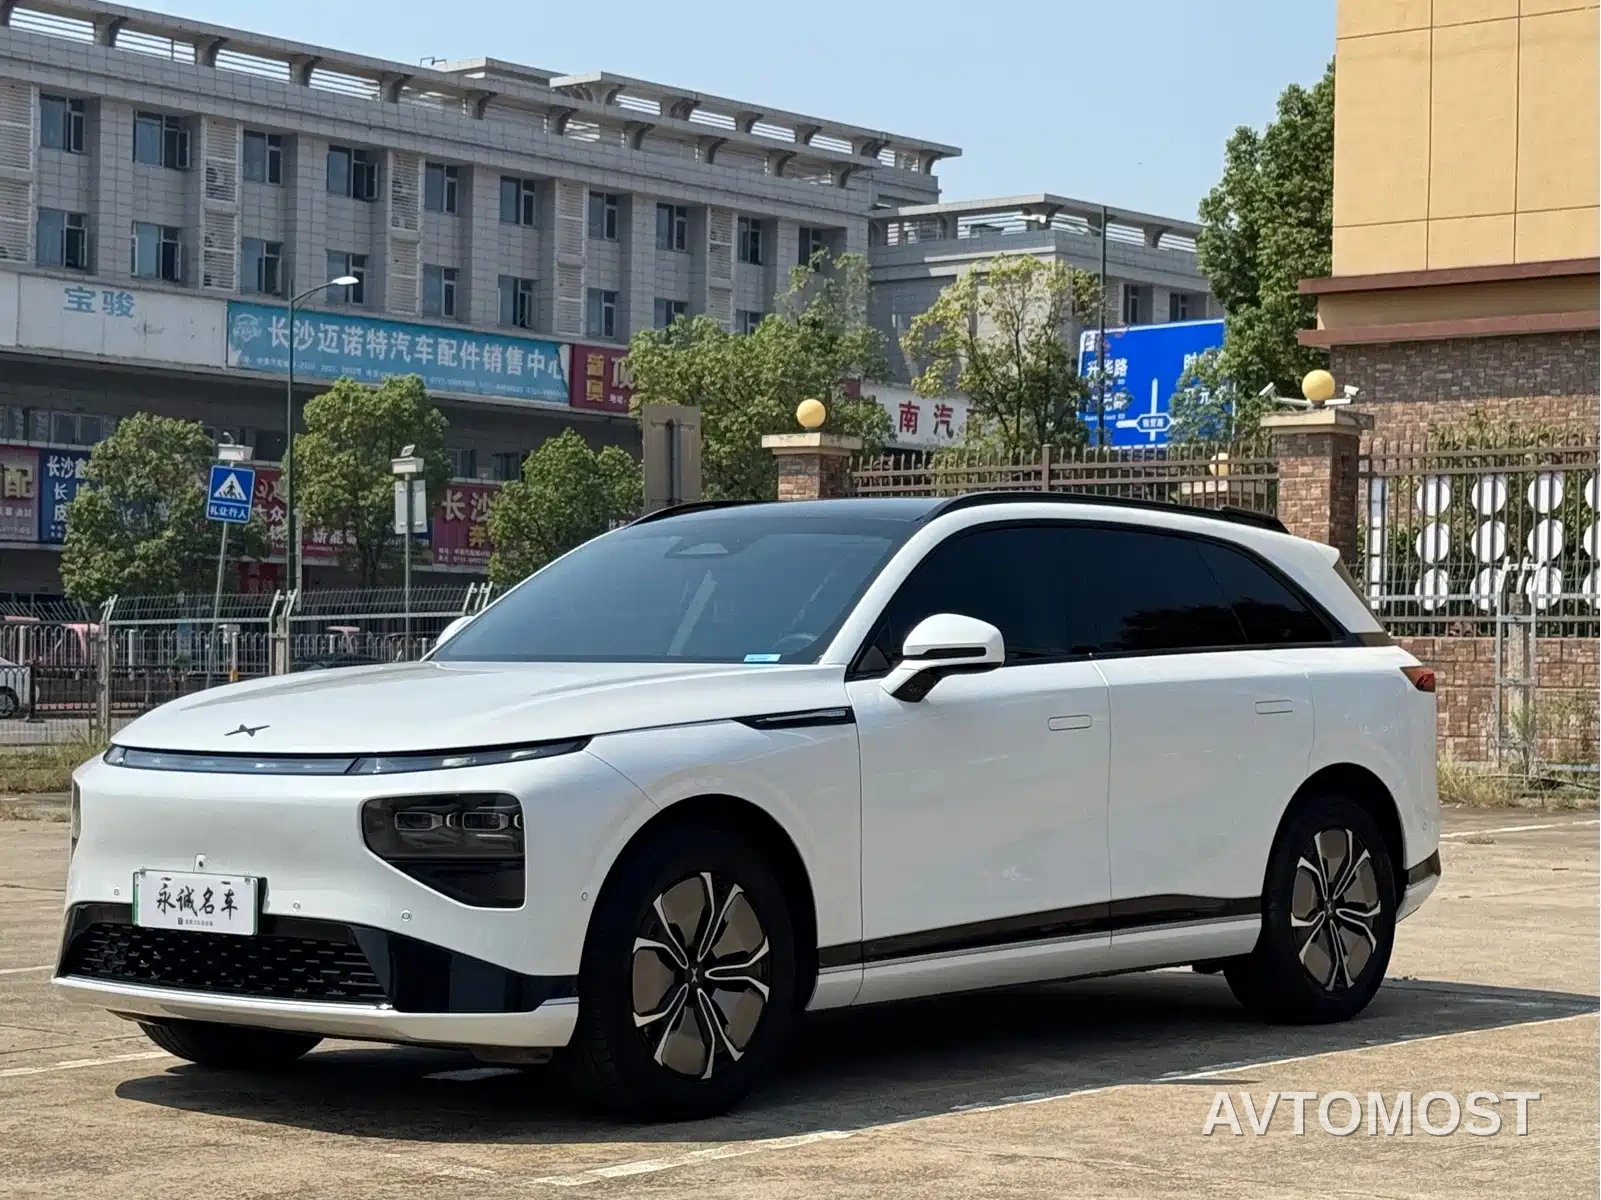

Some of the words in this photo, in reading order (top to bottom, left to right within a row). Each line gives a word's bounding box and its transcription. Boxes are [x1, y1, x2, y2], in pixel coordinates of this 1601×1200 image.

[62, 286, 135, 319] 宝骏
[267, 315, 562, 380] 长沙迈诺特汽车配件销售中心
[898, 400, 980, 439] 南汽
[210, 505, 247, 519] 礼让行人
[156, 883, 239, 920] 永诚名车
